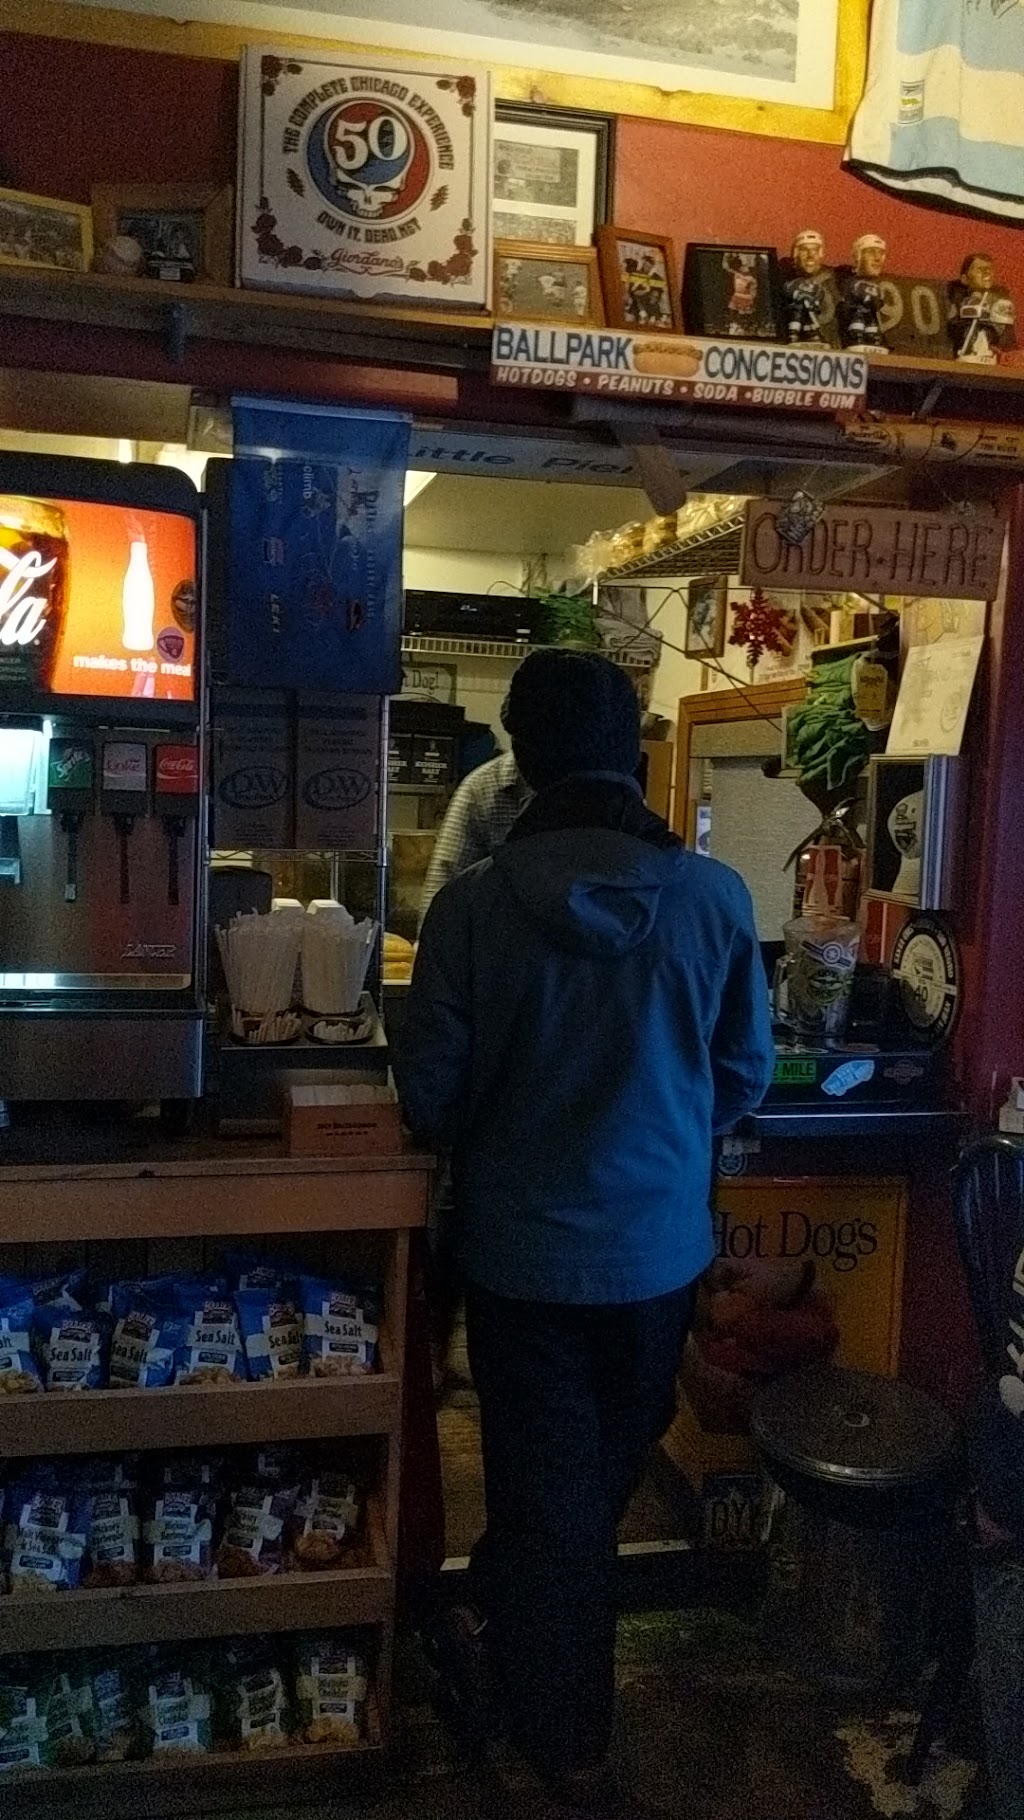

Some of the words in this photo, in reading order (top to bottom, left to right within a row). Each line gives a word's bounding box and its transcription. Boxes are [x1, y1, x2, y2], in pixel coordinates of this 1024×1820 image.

[351, 76, 409, 100] CHICAGO
[289, 78, 348, 127] COMPLETE
[283, 126, 299, 154] THE
[333, 115, 408, 170] 50
[407, 93, 454, 170] EXPERIENCE
[317, 210, 345, 235] OWN
[496, 327, 633, 370] BALLPARK
[704, 345, 865, 389] CONCESSIONS
[496, 366, 577, 387] HOTDOGS
[600, 374, 674, 396] PEANUTS
[693, 382, 738, 402] SODA
[752, 387, 813, 407] BUBBLE
[819, 394, 856, 409] GUM
[891, 521, 994, 588] HERE
[73, 655, 127, 671] makes
[130, 657, 158, 673] the
[784, 1062, 814, 1076] MILE
[777, 1211, 877, 1272] Dogs
[196, 1329, 213, 1343] Sea
[216, 1330, 235, 1345] Salt
[268, 1335, 287, 1349] Sea
[324, 1321, 340, 1334] Sea
[342, 1325, 362, 1337] Salt
[51, 1348, 69, 1361] Sea
[71, 1348, 92, 1361] Salt
